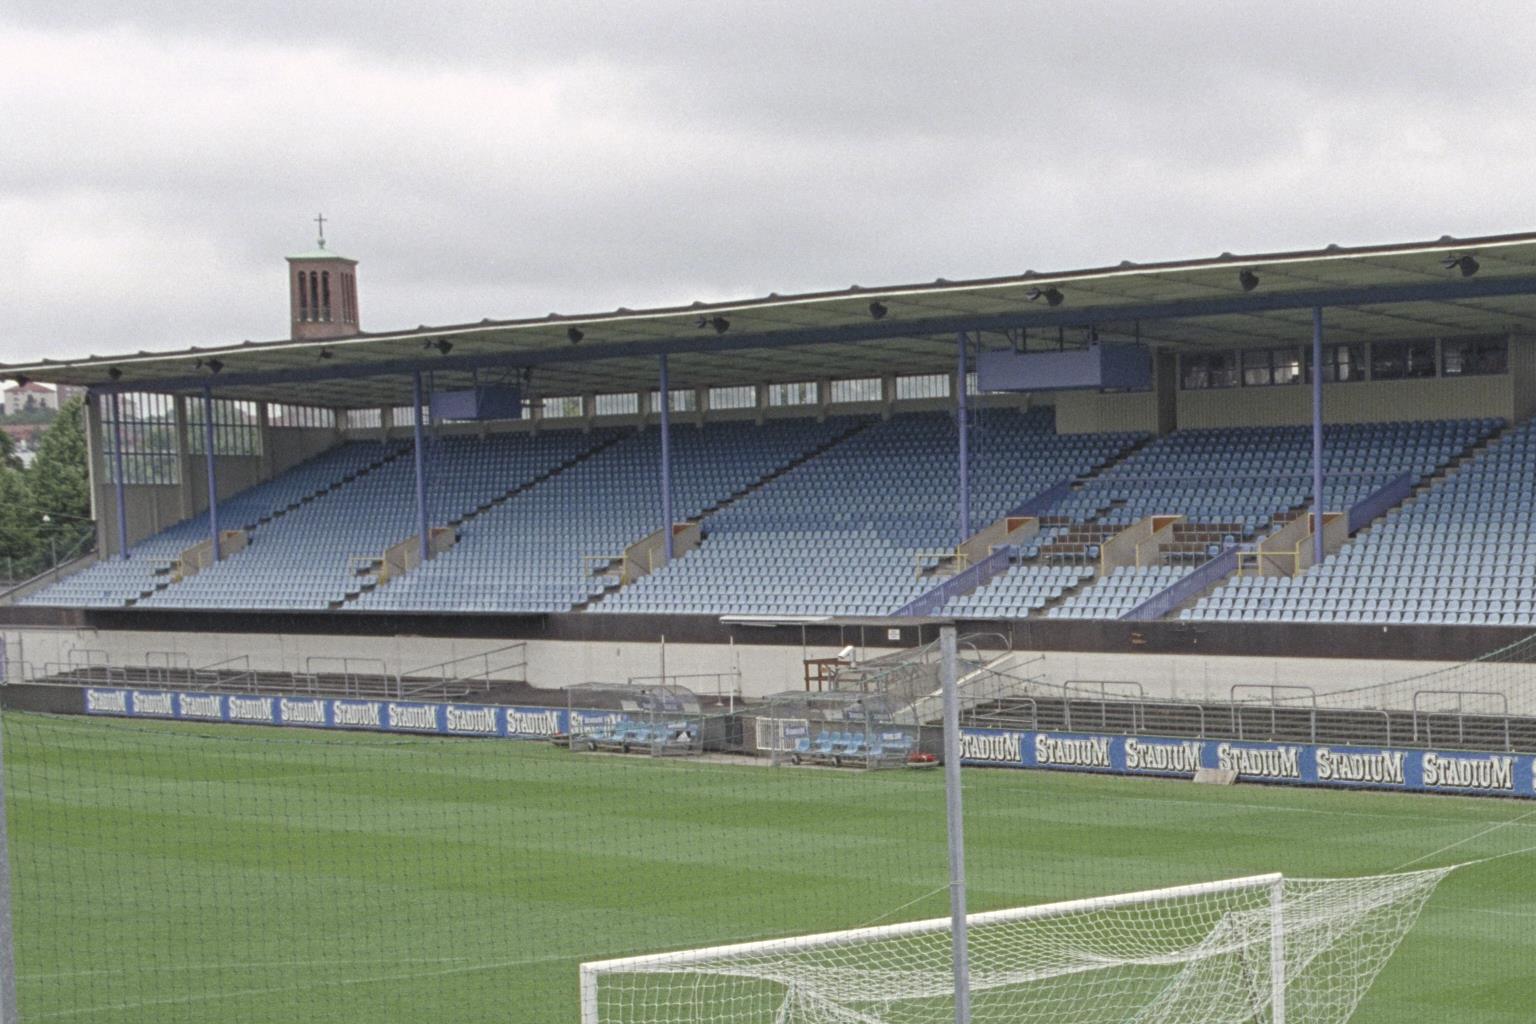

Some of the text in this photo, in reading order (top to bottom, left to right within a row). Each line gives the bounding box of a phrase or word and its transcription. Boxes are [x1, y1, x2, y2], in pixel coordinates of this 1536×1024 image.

[87, 690, 126, 711] STADIUM
[133, 691, 172, 714] STADIUM
[179, 694, 221, 717] STADIUM
[228, 696, 273, 720] STADIUM
[280, 699, 326, 722] STADIUM
[333, 701, 380, 726] STADIUM
[388, 704, 438, 729] STADIUM
[446, 706, 497, 732] STADIUM
[506, 709, 559, 735] STADIUM
[1035, 734, 1110, 767] STADIUM
[1125, 737, 1201, 772] STADIUM
[1217, 743, 1299, 778] STADIUM
[1316, 748, 1404, 784] STADIUM
[1422, 752, 1514, 789] STADIUM
